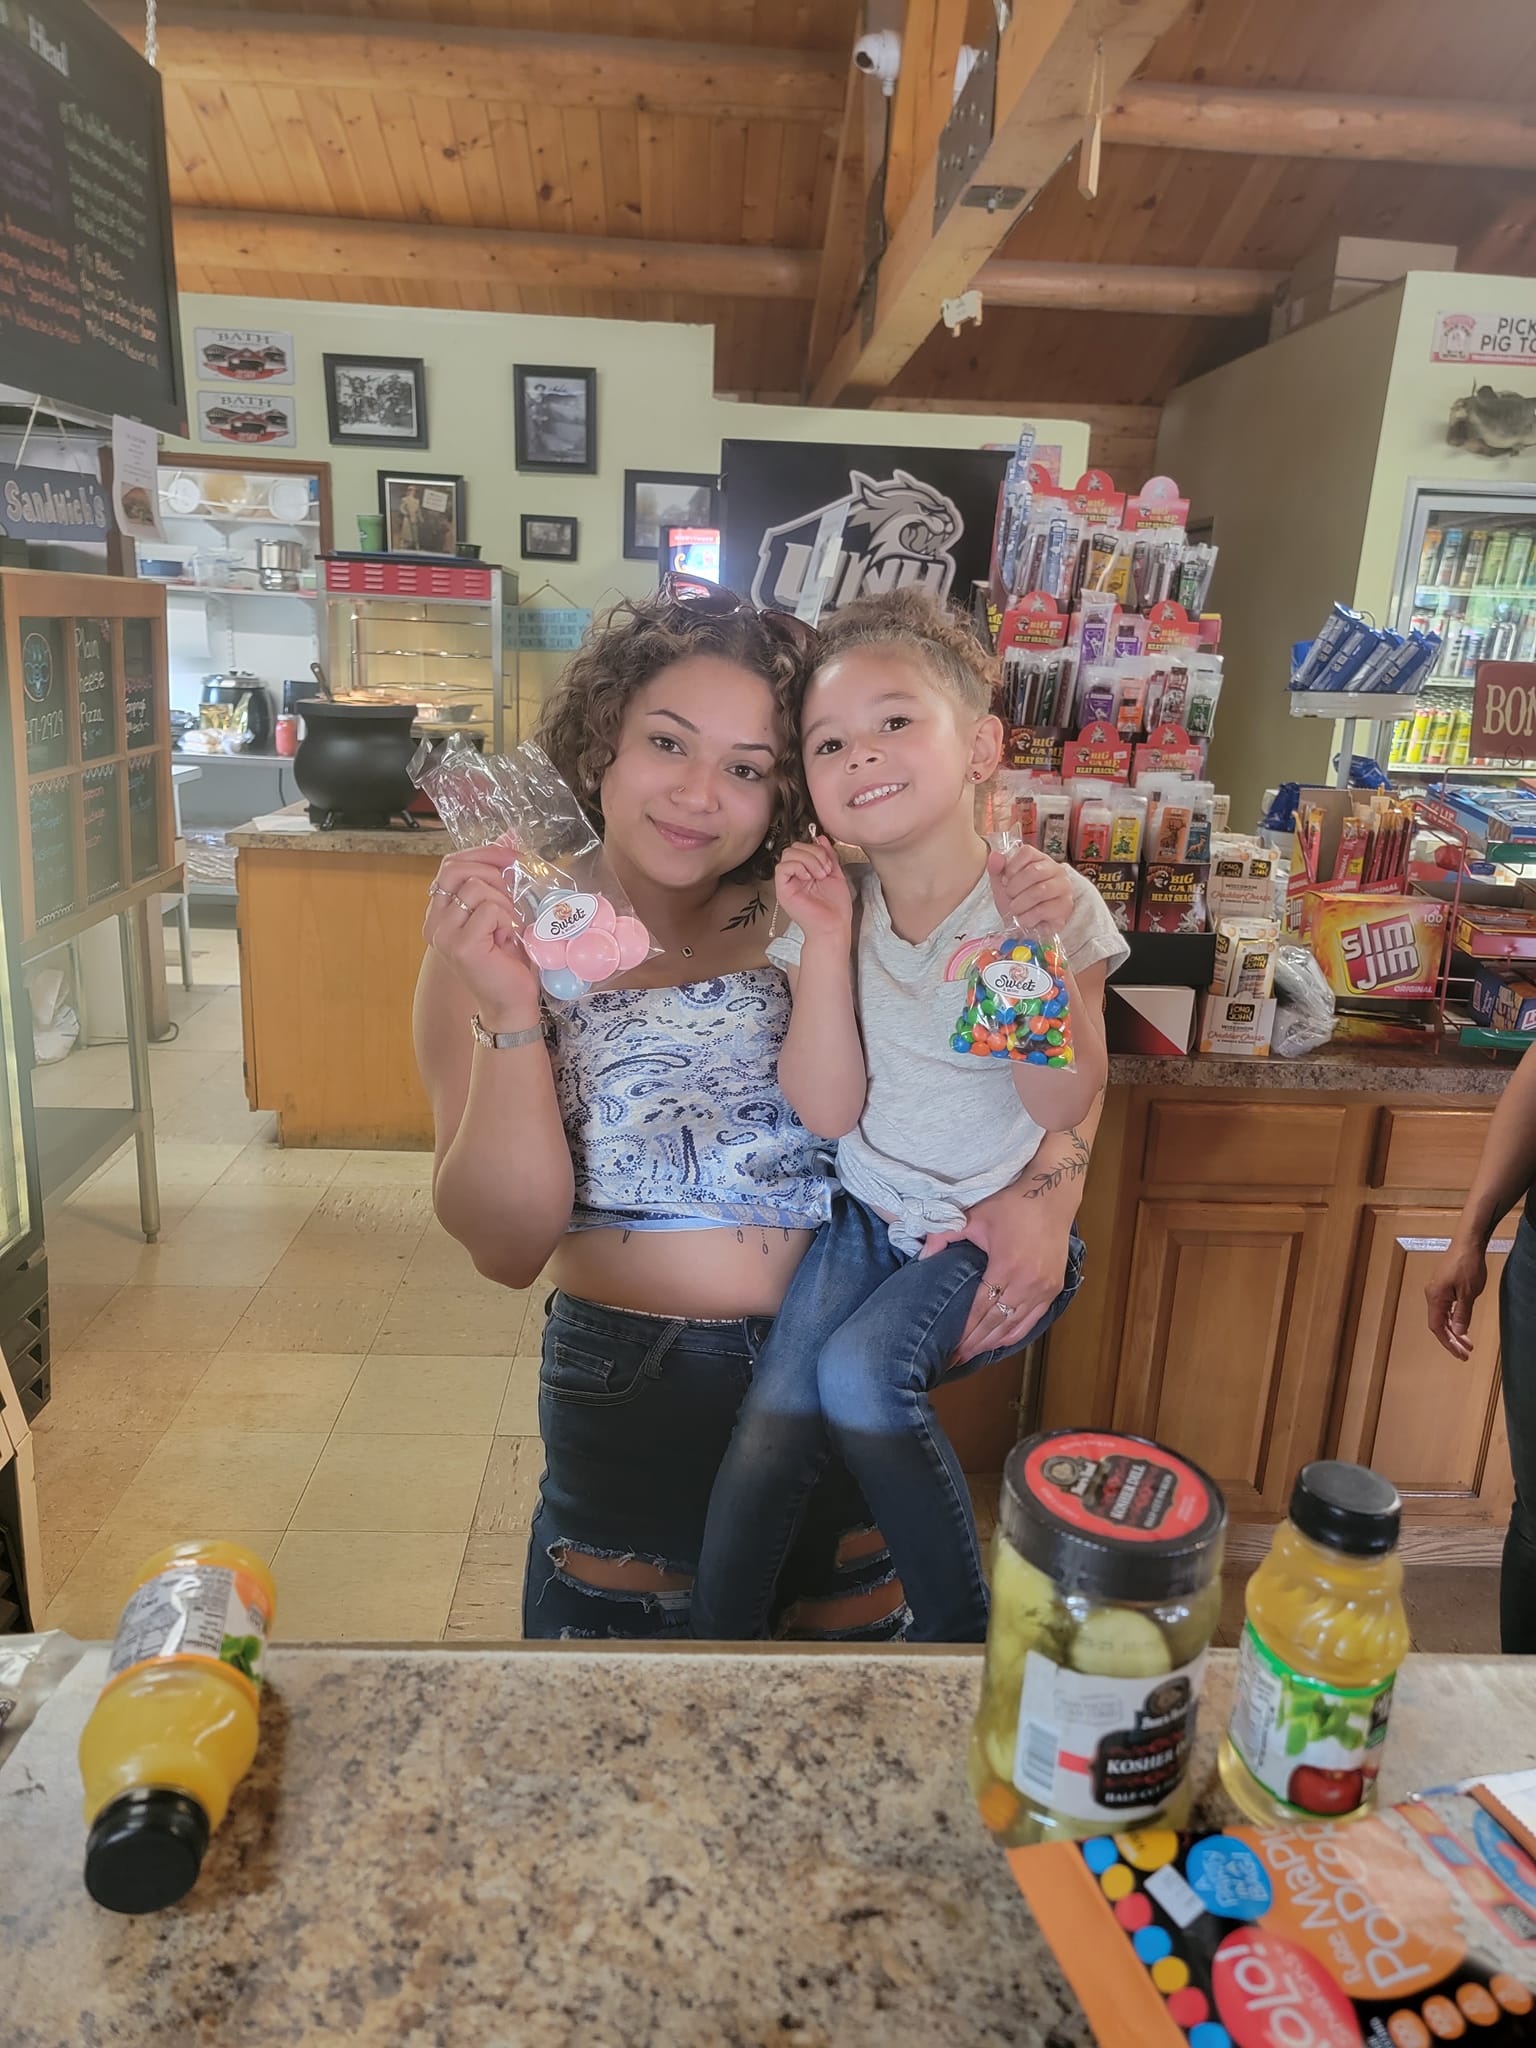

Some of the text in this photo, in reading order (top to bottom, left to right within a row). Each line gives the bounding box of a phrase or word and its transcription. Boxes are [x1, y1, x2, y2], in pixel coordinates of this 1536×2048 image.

[218, 333, 271, 345] BATH
[1480, 334, 1511, 352] PIG
[220, 395, 273, 408] BATH
[1032, 737, 1056, 748] BIG
[1098, 871, 1122, 882] BIG
[1170, 873, 1194, 884] BIG
[1097, 881, 1135, 893] GAME
[1168, 883, 1206, 894] GAME
[1424, 913, 1443, 924] 100
[1394, 984, 1433, 994] ORIGINAL
[1106, 1749, 1174, 1775] KOSHER
